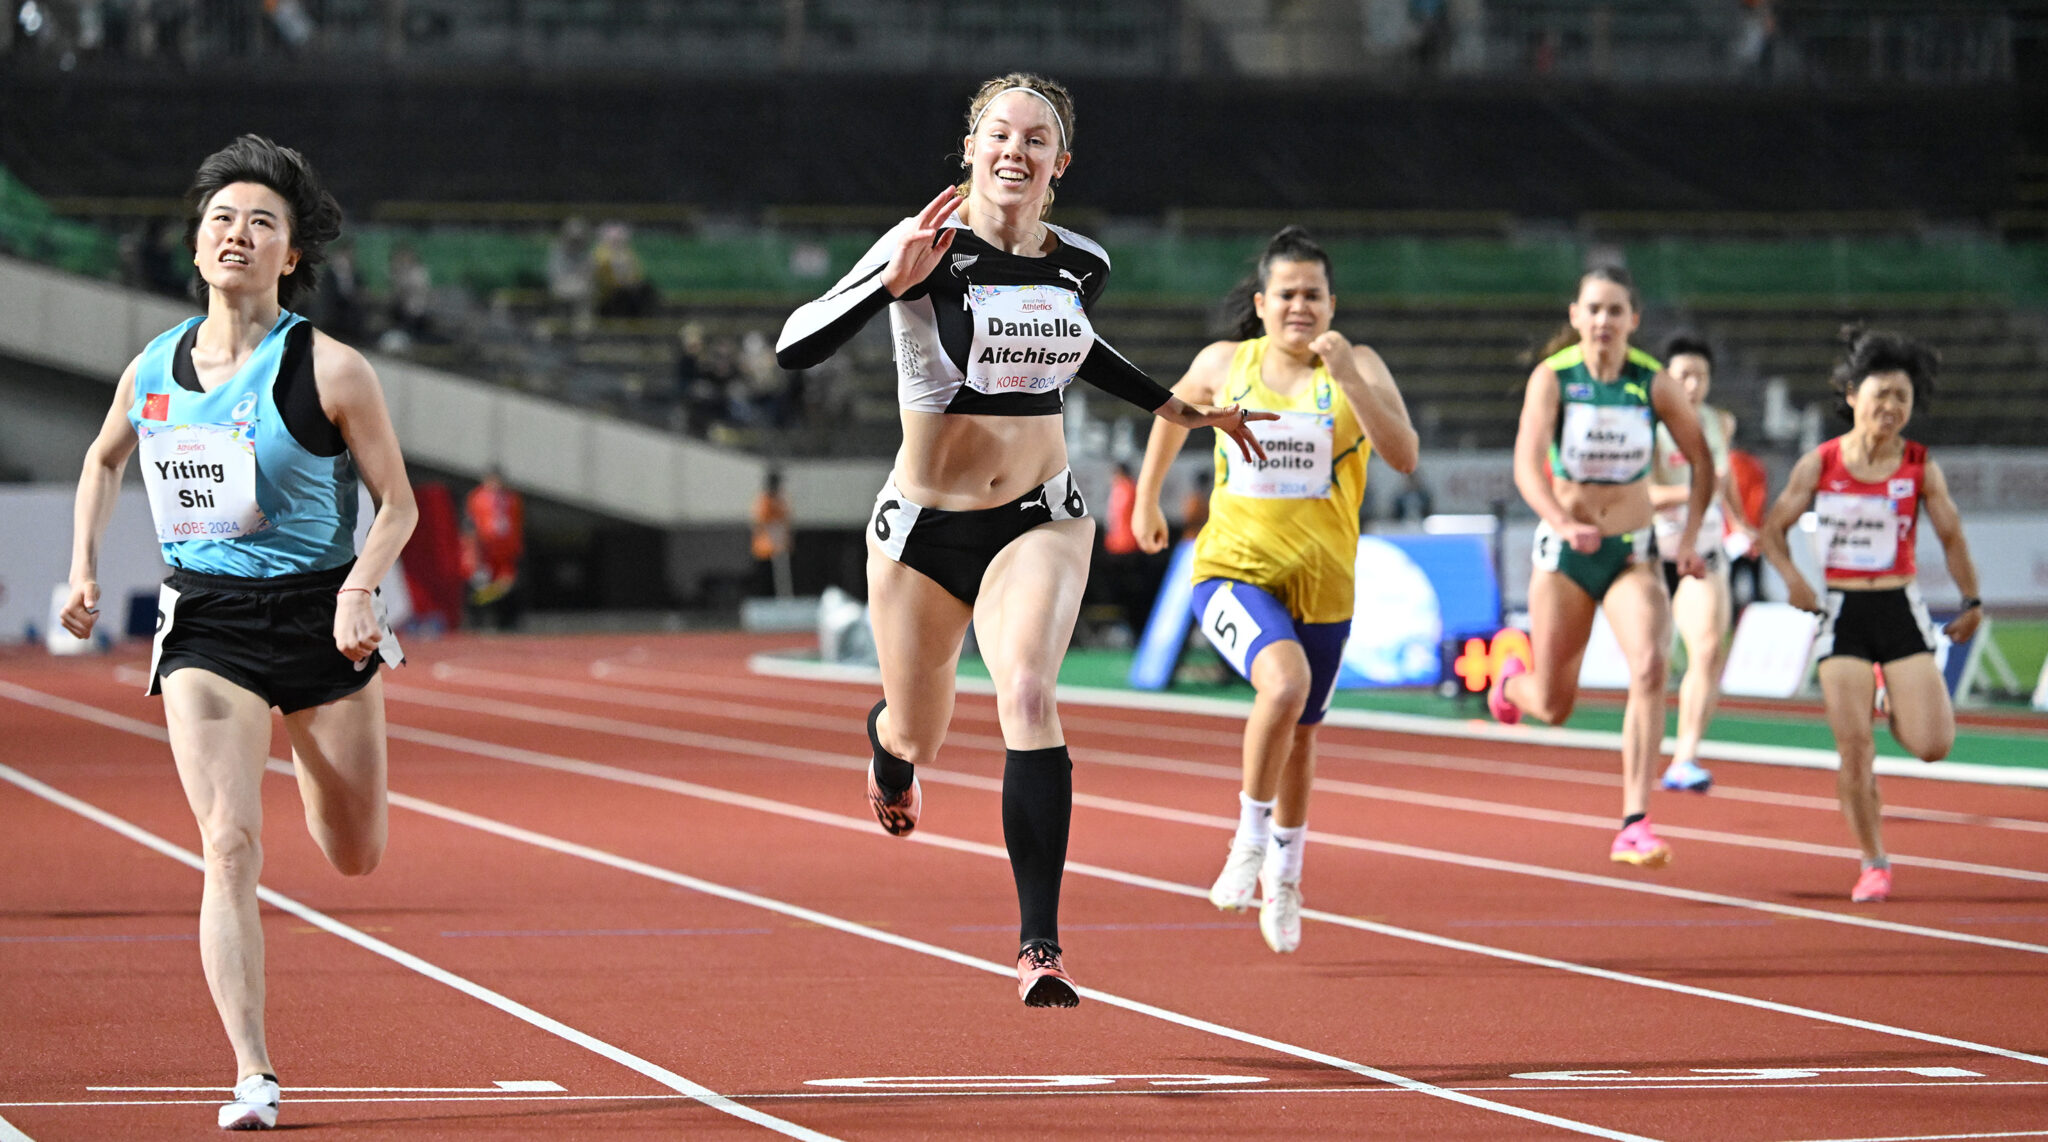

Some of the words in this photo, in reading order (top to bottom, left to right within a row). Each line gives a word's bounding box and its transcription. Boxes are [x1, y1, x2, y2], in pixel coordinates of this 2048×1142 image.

[1022, 303, 1053, 311] Athletics
[988, 317, 1082, 338] Danielle
[978, 346, 1081, 365] Aitchison
[996, 376, 1028, 388] KOBE
[1029, 375, 1056, 389] 2024
[155, 460, 225, 483] Yiting
[178, 489, 215, 508] Shi
[1064, 470, 1085, 518] 6
[173, 522, 208, 536] KOBE
[208, 521, 241, 534] 2024
[875, 500, 901, 541] 6
[1214, 610, 1238, 649] 5
